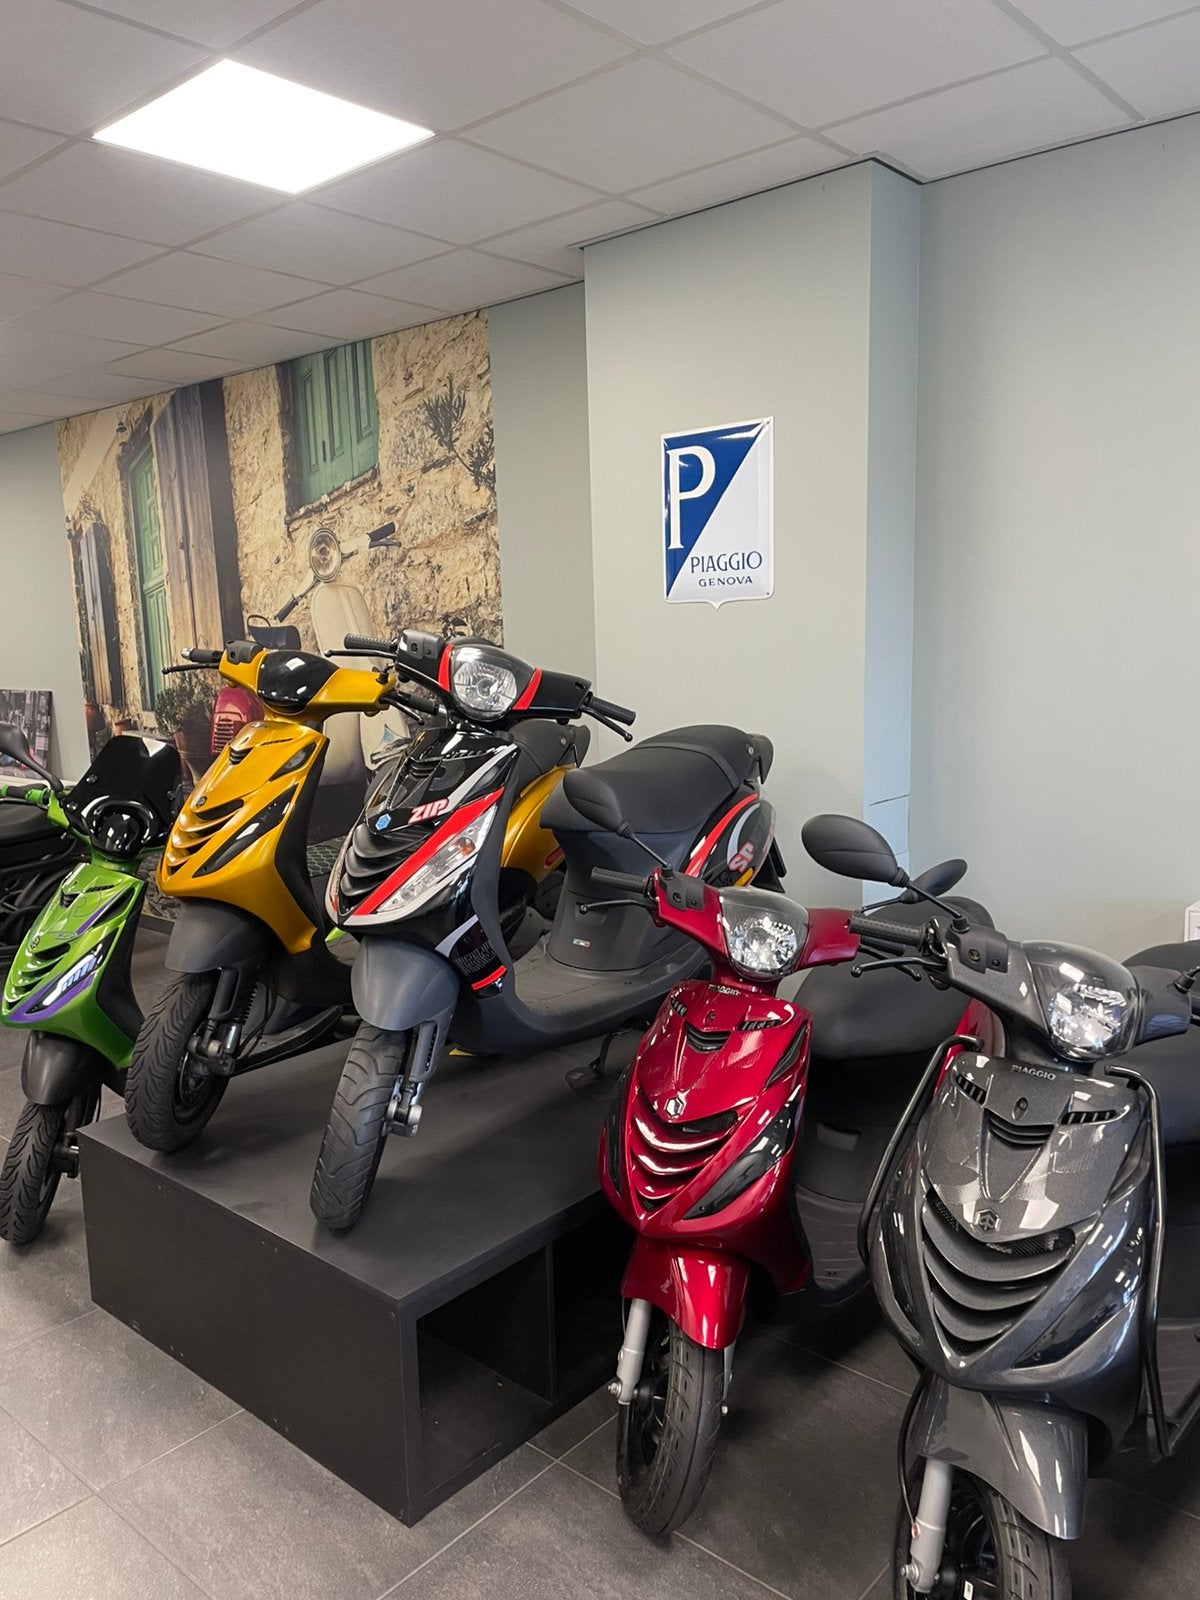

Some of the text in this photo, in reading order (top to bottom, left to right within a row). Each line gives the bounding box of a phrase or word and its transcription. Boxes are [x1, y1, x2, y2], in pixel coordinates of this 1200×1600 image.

[666, 446, 716, 549] P
[690, 551, 763, 574] PIAGGIO
[698, 576, 753, 587] GENOVA
[408, 798, 449, 826] ZIP
[729, 842, 754, 873] SP
[1012, 1064, 1057, 1080] PIAGGIO
